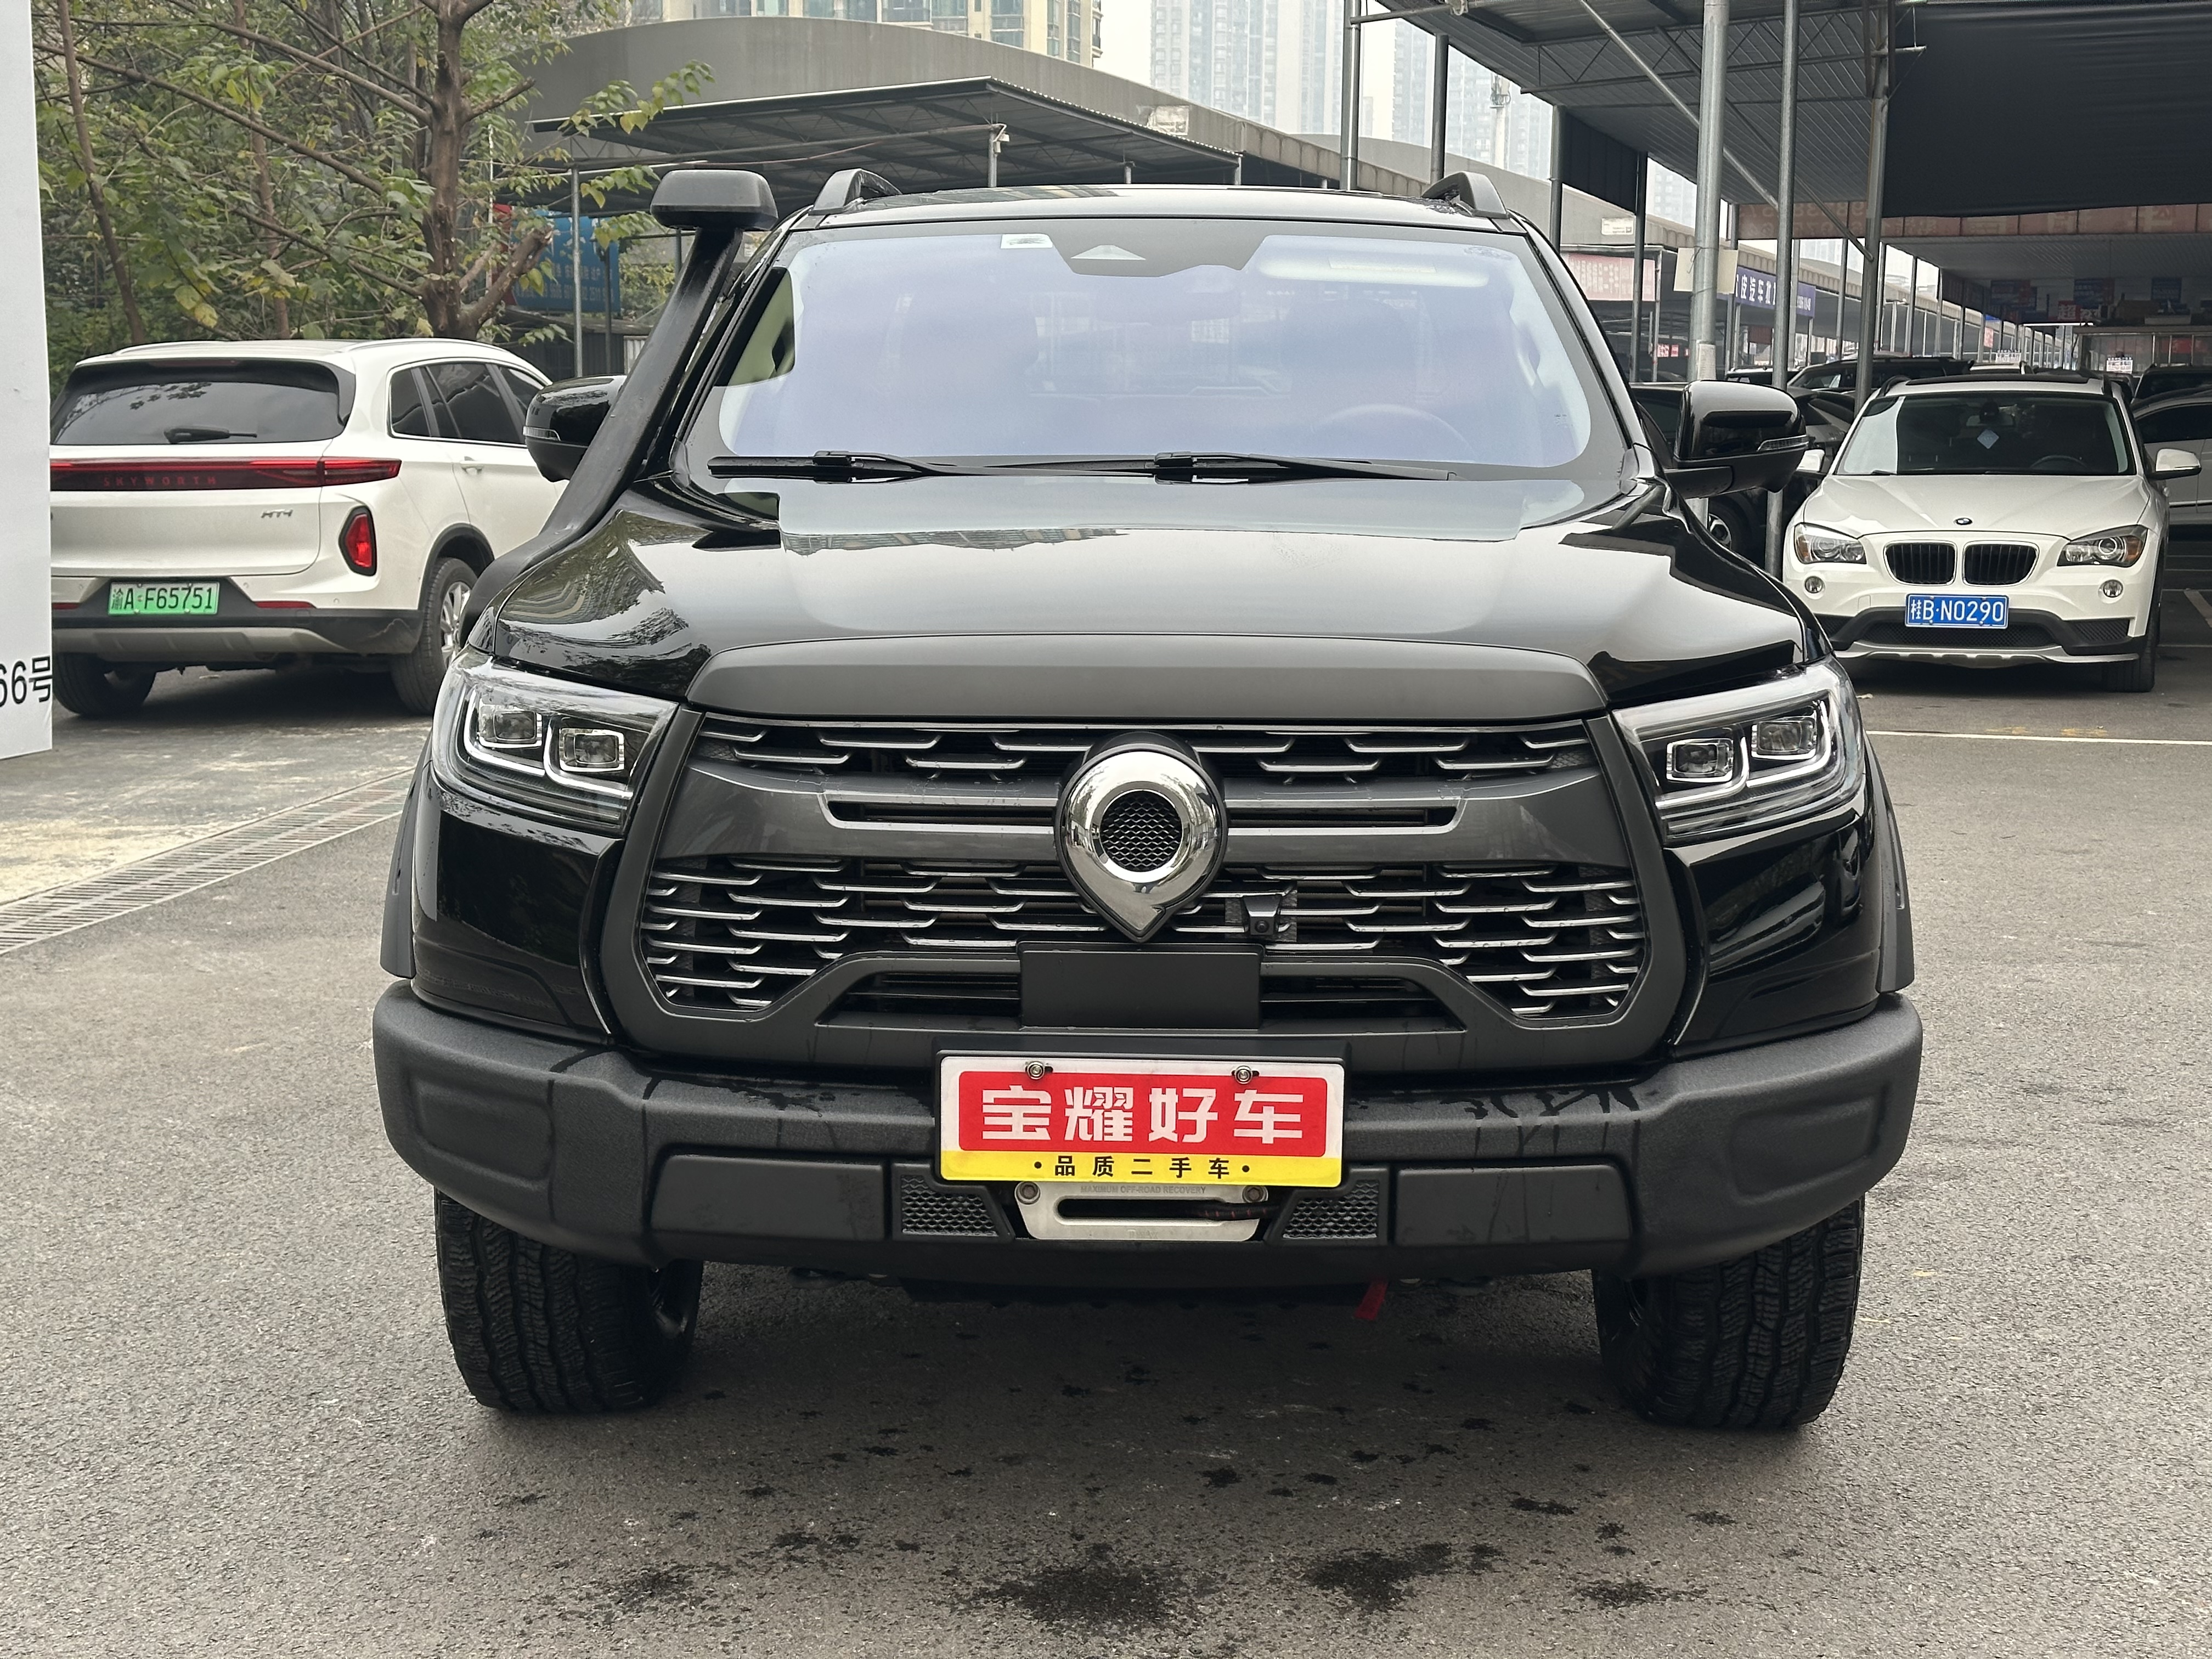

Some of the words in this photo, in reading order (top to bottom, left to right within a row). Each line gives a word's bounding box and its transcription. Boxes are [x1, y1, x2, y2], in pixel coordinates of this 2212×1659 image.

[103, 476, 216, 487] SKYWORTH
[1911, 599, 2004, 622] 桂B·N0290
[982, 1084, 1304, 1144] 宝耀好车
[1120, 1186, 1160, 1194] OFF-ROAD
